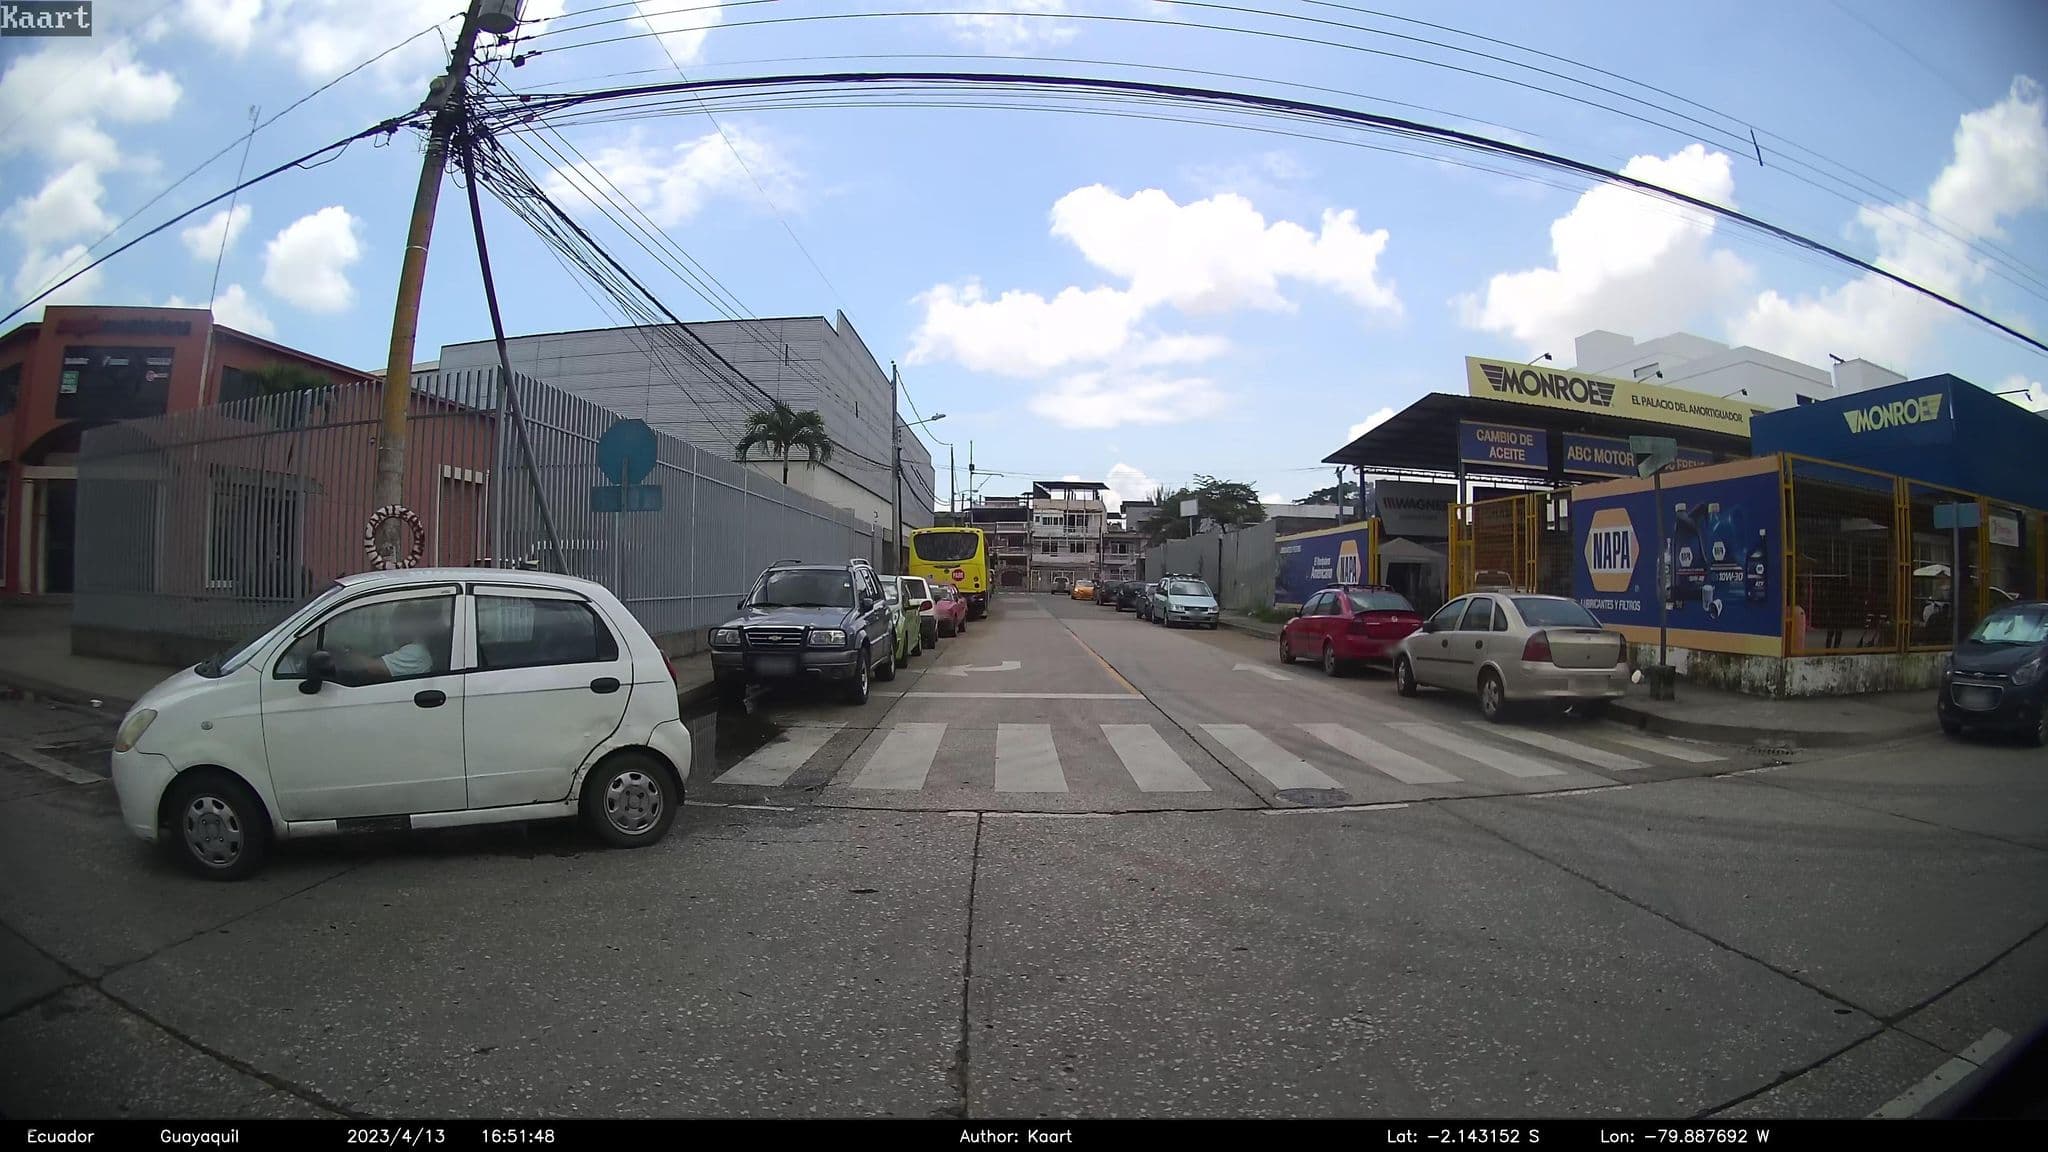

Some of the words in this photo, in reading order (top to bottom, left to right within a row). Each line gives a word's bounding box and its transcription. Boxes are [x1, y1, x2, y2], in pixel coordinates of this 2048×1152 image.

[1502, 367, 1604, 407] MONROE
[1631, 394, 1641, 406] EL
[1641, 396, 1675, 411] PALACIO
[1674, 402, 1689, 413] DEL
[1689, 405, 1744, 423] AMORTIGUADOR
[1855, 396, 1933, 434] MONROE
[1476, 429, 1518, 446] CAMBIO
[1519, 434, 1534, 446] DE
[1488, 446, 1526, 461] ACEITE
[1567, 446, 1593, 462] ABC
[1594, 448, 1635, 467] MOTOR
[1593, 530, 1631, 570] NAPA
[1614, 600, 1619, 610] Y
[1619, 599, 1641, 612] FILTROS
